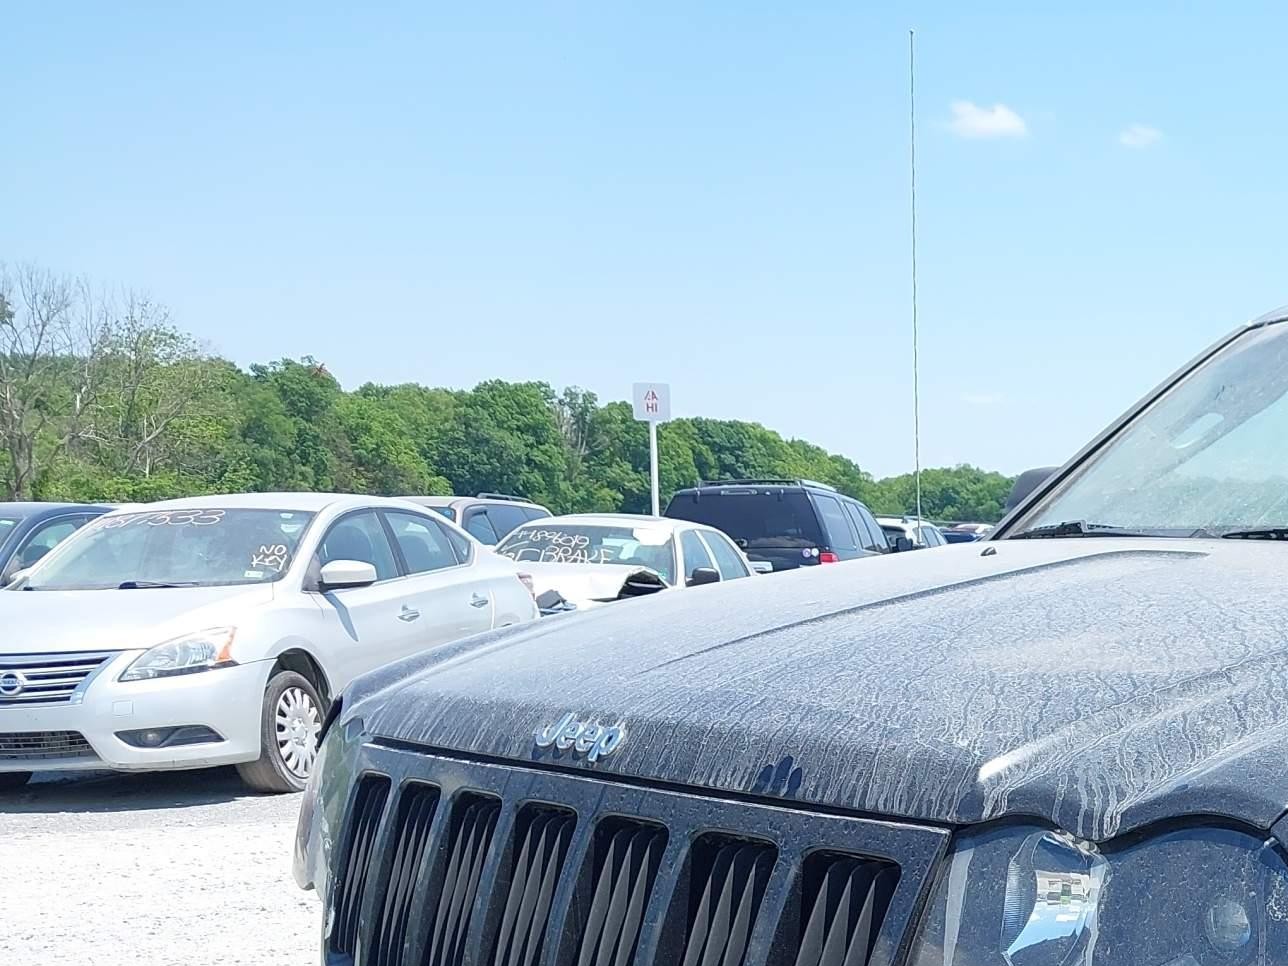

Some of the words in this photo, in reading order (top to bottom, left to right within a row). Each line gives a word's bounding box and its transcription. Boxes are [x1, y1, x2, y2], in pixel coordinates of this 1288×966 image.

[645, 402, 659, 413] HI
[260, 544, 287, 555] NO
[251, 554, 288, 572] KEY
[534, 712, 627, 763] Jeep
